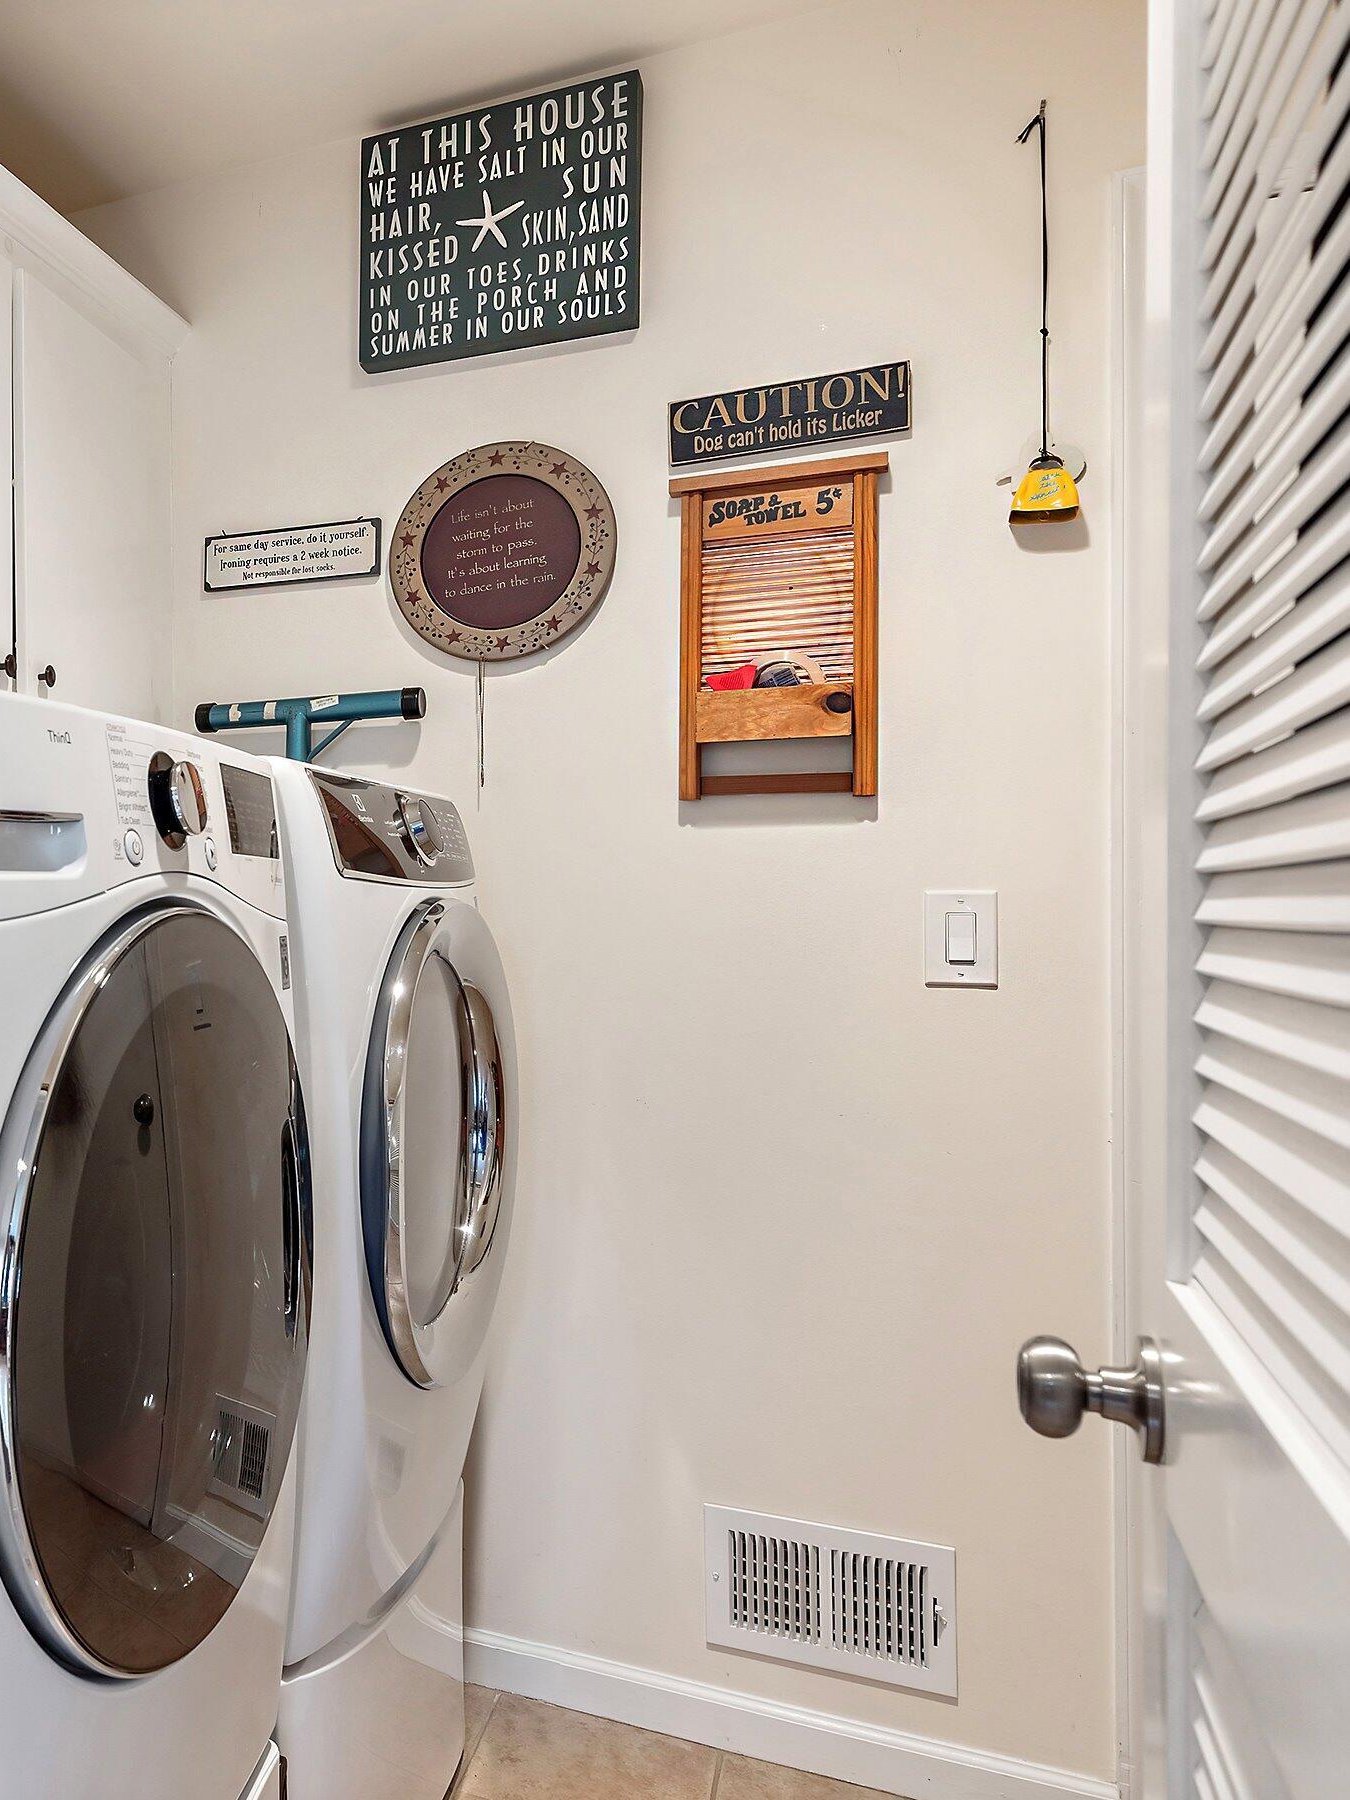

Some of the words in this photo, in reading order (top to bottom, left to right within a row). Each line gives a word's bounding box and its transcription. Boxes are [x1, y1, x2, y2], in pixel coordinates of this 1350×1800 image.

[367, 137, 400, 178] AT
[420, 113, 492, 165] THIS
[513, 80, 628, 142] HOUSE
[368, 176, 397, 208] WE
[409, 160, 464, 199] HAVE
[478, 145, 527, 184] SALT
[542, 136, 565, 168] IN
[580, 122, 628, 159] OUR
[369, 202, 442, 242] HAIR,
[562, 155, 626, 199] SUN
[368, 234, 460, 280] KISSED
[369, 284, 392, 309] IN
[407, 273, 451, 301] OUR
[538, 236, 629, 276] DRINKS
[370, 308, 400, 334] ON
[417, 297, 460, 326] THE
[477, 278, 557, 314] PORCH
[576, 265, 627, 296] AND
[370, 323, 453, 358] SUMMER
[466, 315, 488, 341] IN
[501, 305, 544, 334] OUR
[557, 289, 627, 325] SOULS
[673, 365, 905, 434] CAUTION!
[693, 435, 723, 454] Dog
[728, 426, 765, 448] can't
[769, 418, 802, 441] hold
[806, 416, 827, 436] its
[832, 408, 884, 432] Licker
[451, 509, 471, 524] Life
[474, 504, 498, 519] isn't
[501, 499, 535, 515] about
[708, 494, 765, 528] SOAP
[768, 494, 782, 506] &
[743, 500, 807, 526] TOWEL
[213, 543, 228, 556] For
[229, 541, 252, 553] same
[253, 539, 269, 551] day
[307, 533, 318, 544] do
[319, 531, 328, 543] it
[329, 527, 369, 544] yourself.
[451, 527, 491, 543] waiting
[493, 522, 510, 535] for
[515, 518, 534, 531] the
[220, 555, 252, 572] Ironing
[253, 553, 290, 567] requires
[292, 553, 299, 562] a
[300, 550, 306, 561] 2
[308, 548, 330, 560] week
[331, 546, 363, 558] notice.
[456, 545, 488, 560] storm
[491, 543, 503, 553] to
[507, 537, 537, 556] pass.
[242, 571, 254, 581] Not
[255, 567, 291, 579] responsible
[291, 566, 301, 575] for
[302, 565, 315, 574] lost
[316, 563, 336, 572] socks.
[447, 567, 466, 580] It's
[468, 562, 501, 577] about
[503, 554, 548, 568] learning
[444, 588, 457, 599] to
[459, 582, 493, 597] dance
[496, 579, 507, 590] in
[510, 574, 530, 588] the
[533, 571, 556, 585] rain.
[47, 729, 72, 745] ThinQ
